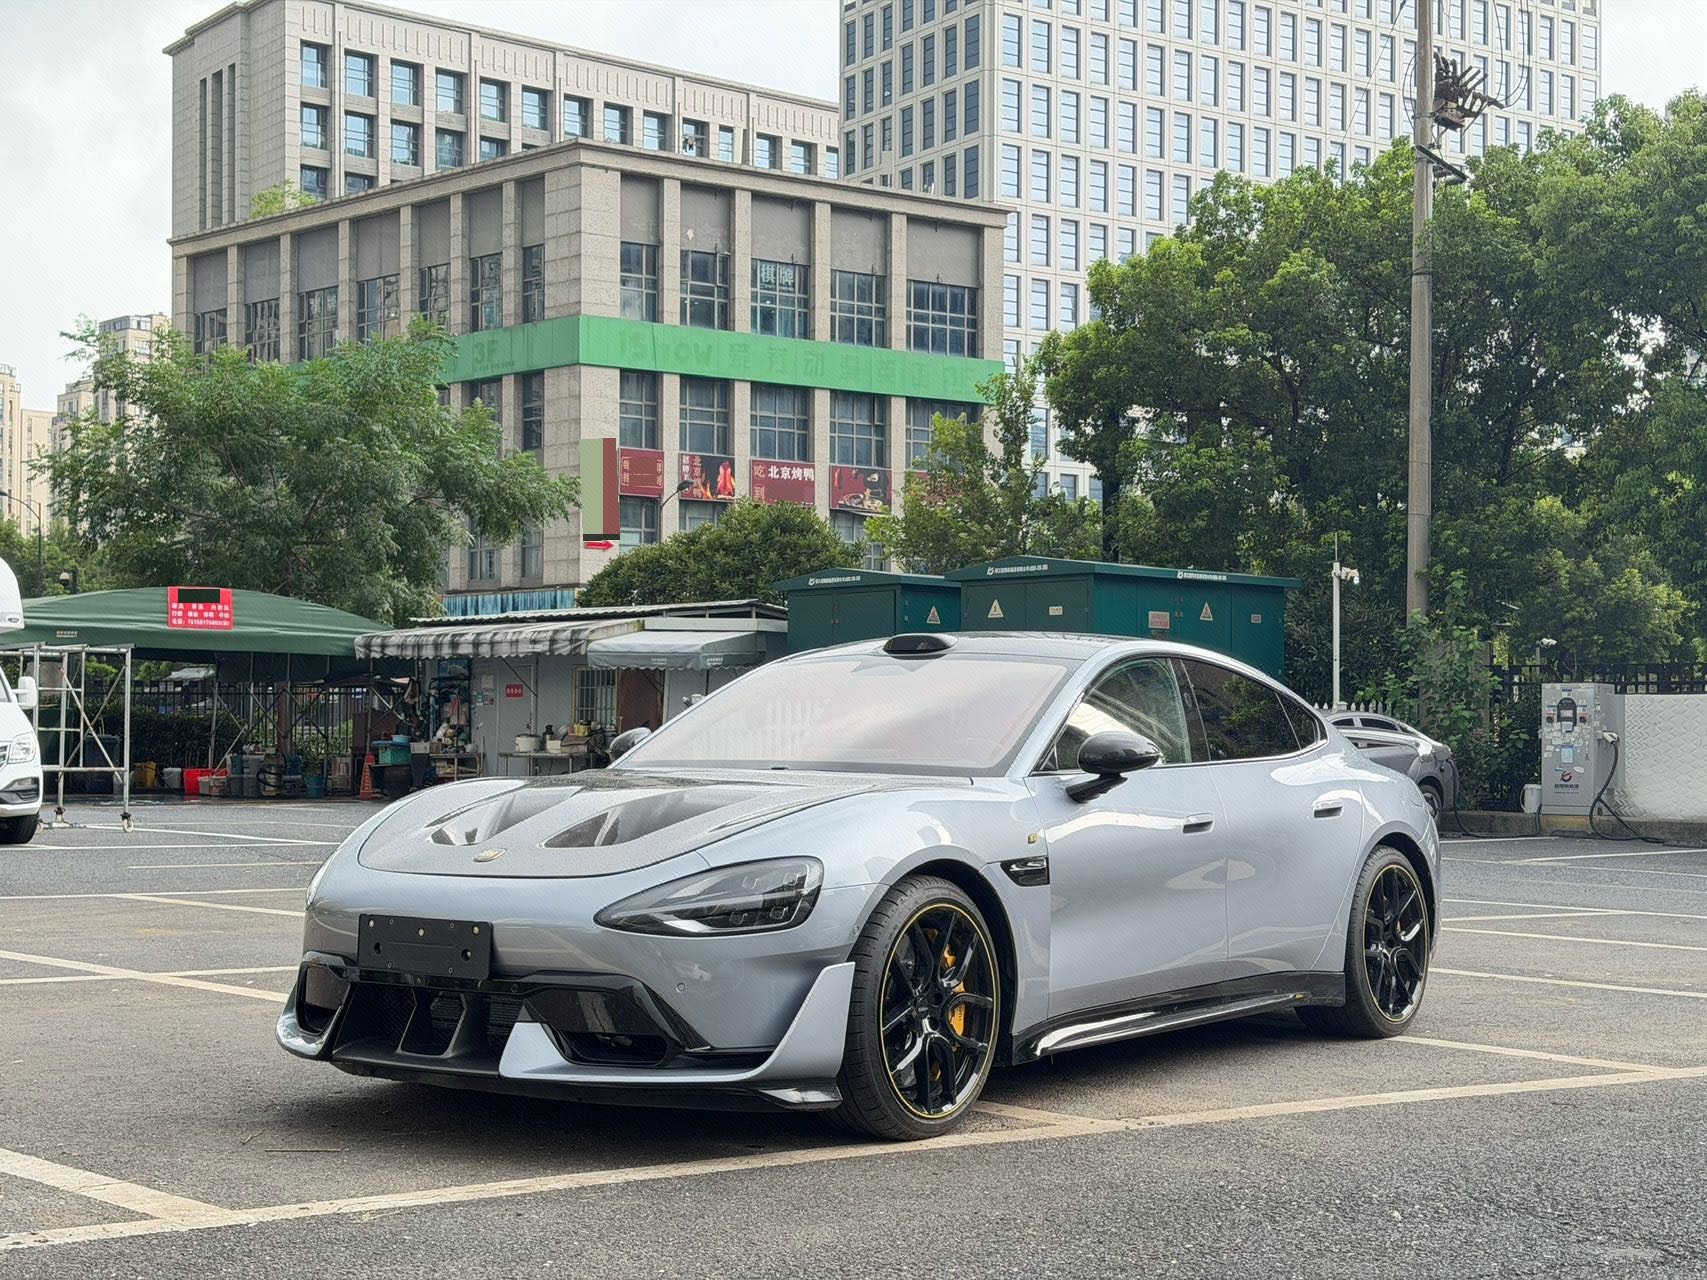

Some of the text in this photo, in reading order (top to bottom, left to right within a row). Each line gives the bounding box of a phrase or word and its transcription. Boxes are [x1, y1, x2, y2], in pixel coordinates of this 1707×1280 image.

[761, 264, 794, 285] 棋牌
[768, 465, 815, 482] 北京烤鸭
